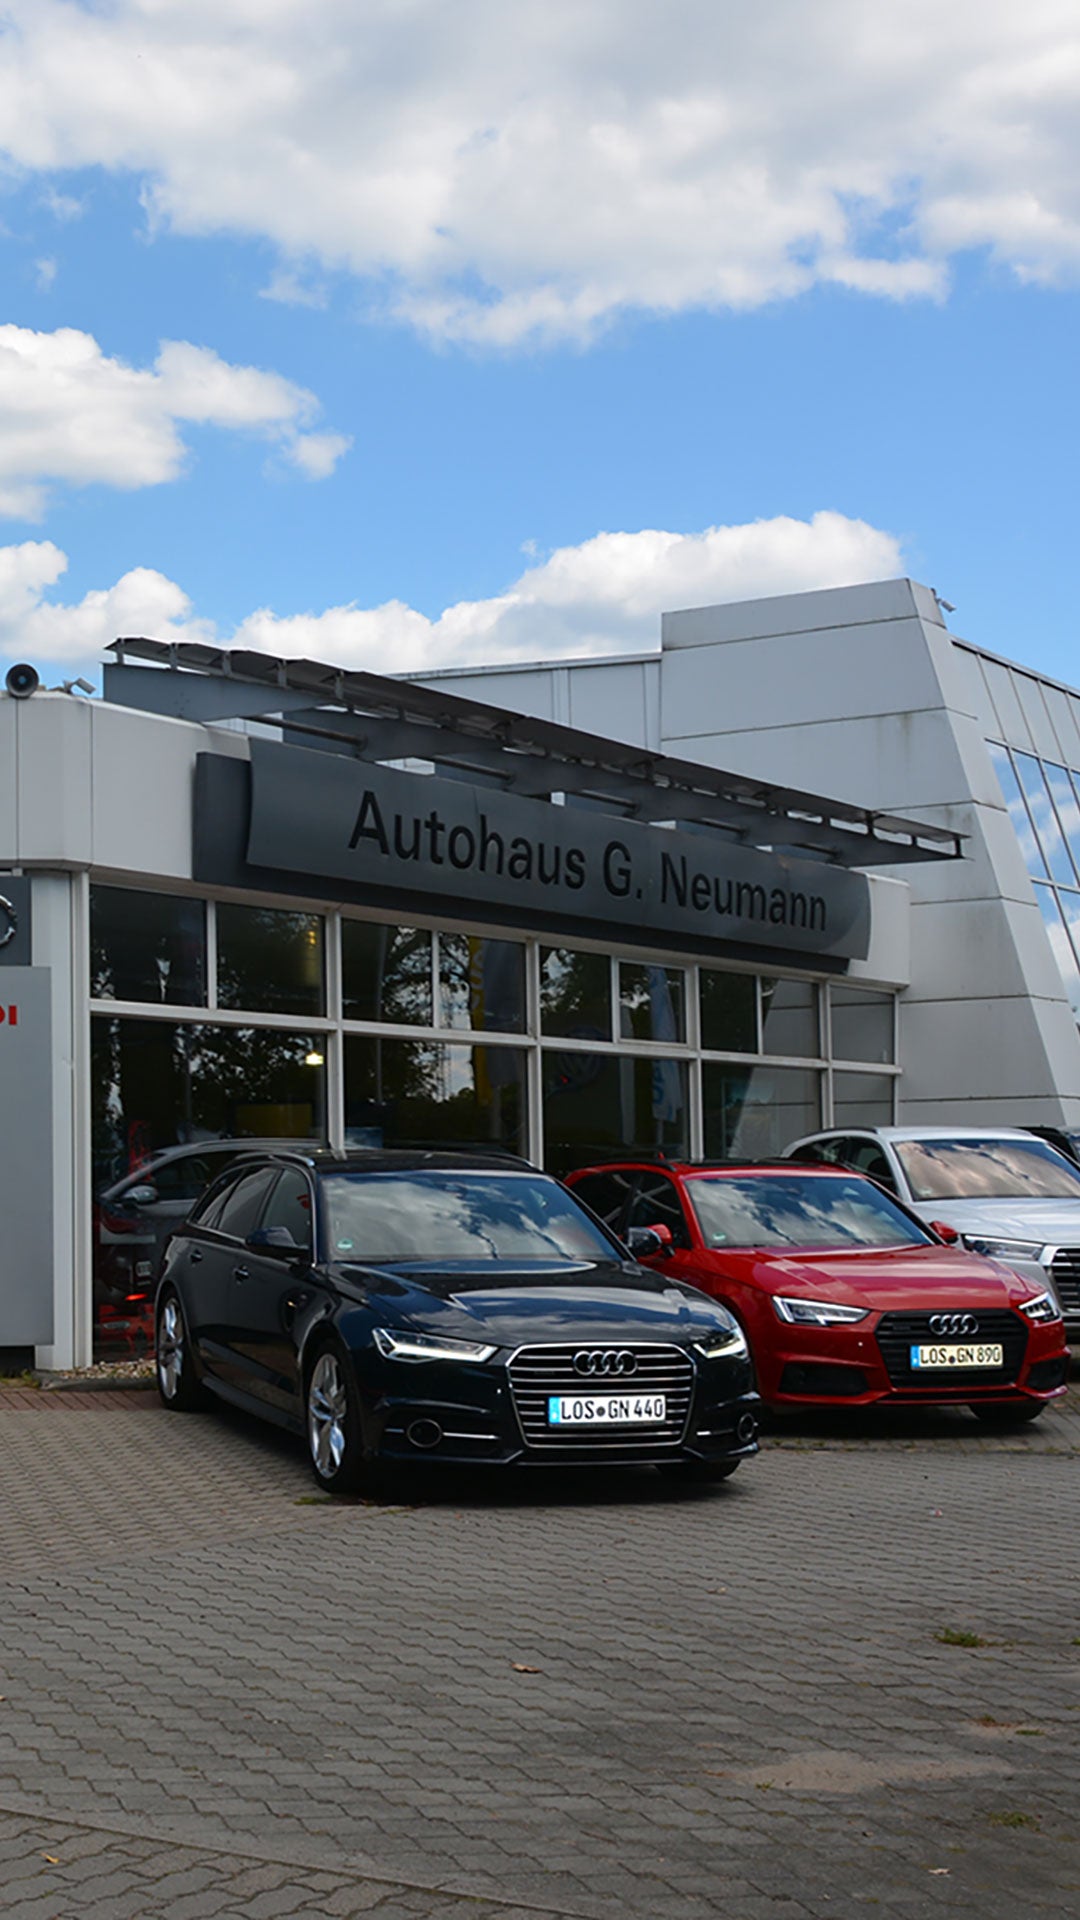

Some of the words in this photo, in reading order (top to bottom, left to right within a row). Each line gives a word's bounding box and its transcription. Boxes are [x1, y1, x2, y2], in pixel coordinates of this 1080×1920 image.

[348, 790, 586, 890] Autohaus
[602, 841, 642, 899] G.
[661, 852, 827, 931] Neumann
[920, 1347, 947, 1365] LOS
[956, 1347, 974, 1364] GN
[977, 1346, 1001, 1363] 890
[561, 1400, 595, 1420] LOS
[608, 1399, 630, 1419] GN
[634, 1398, 663, 1418] 440
